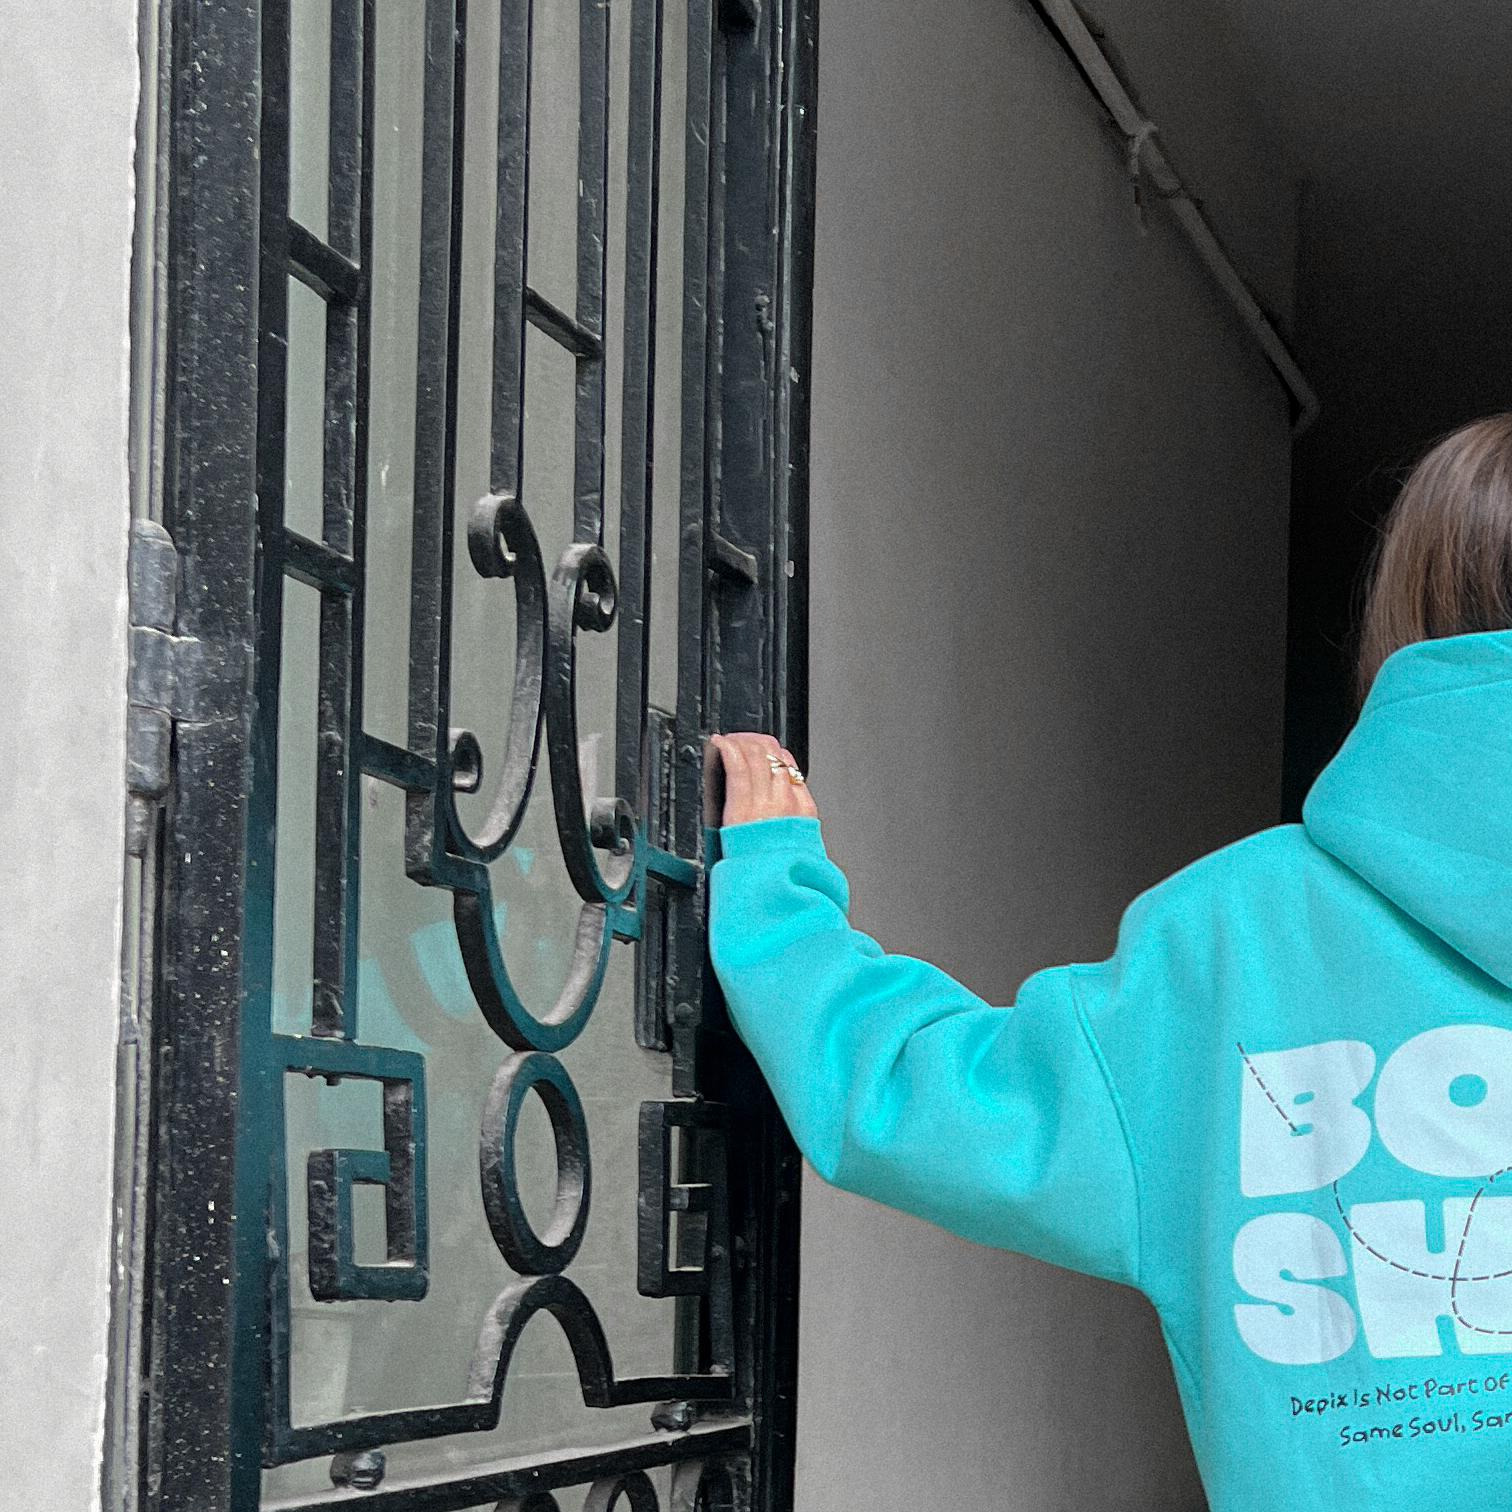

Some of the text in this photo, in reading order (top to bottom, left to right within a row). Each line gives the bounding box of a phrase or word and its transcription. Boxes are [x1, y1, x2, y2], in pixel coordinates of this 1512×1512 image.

[1290, 1392, 1347, 1416] Depix
[1353, 1389, 1370, 1408] Is
[1376, 1383, 1418, 1405] Not
[1424, 1378, 1478, 1398] Part
[1484, 1373, 1509, 1391] Of
[1340, 1424, 1404, 1447] Same
[1408, 1412, 1466, 1437] Soul,
